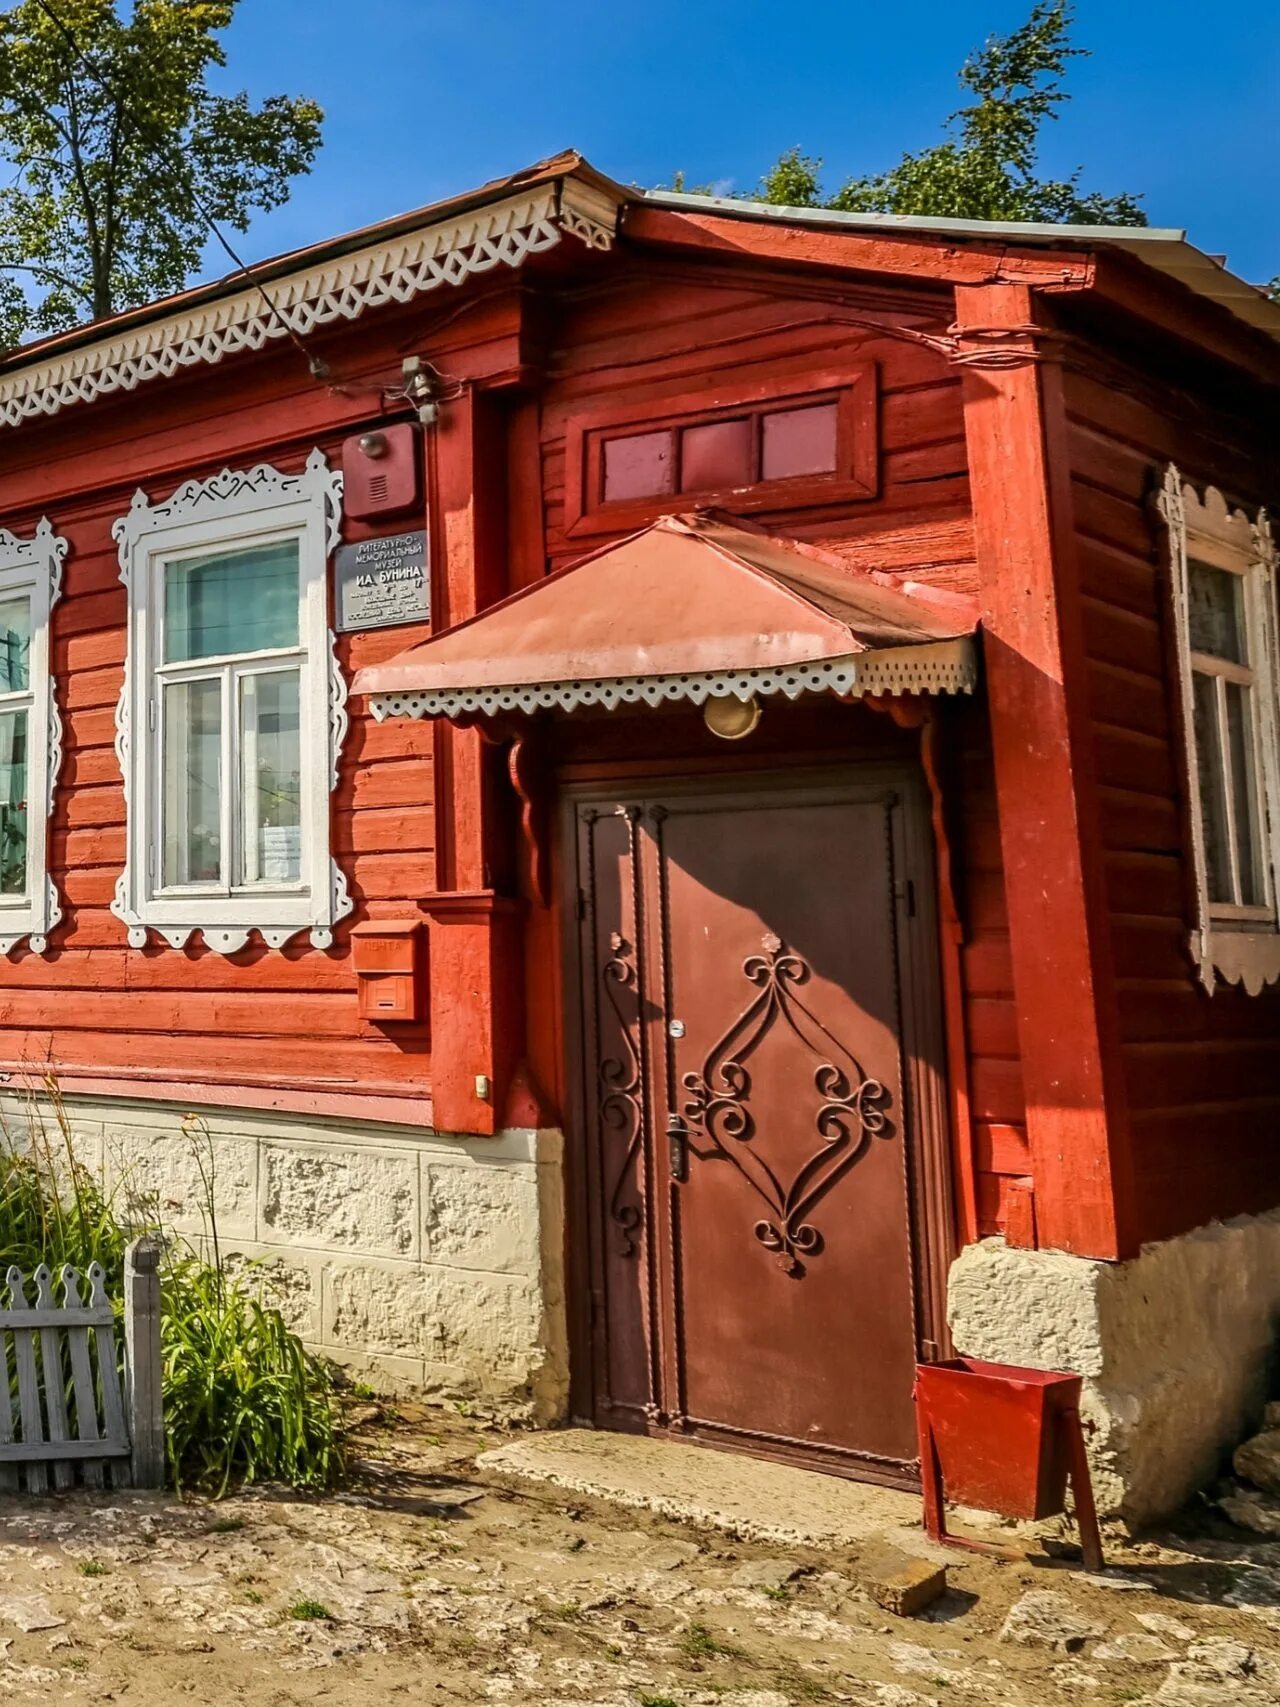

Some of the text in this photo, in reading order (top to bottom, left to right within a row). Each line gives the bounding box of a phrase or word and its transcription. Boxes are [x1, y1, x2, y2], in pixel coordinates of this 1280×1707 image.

[355, 543, 422, 564] МЕМОРИАЛЬНЫЙ
[374, 558, 402, 570] МУЗЕЙ
[379, 566, 421, 582] БУНИНА
